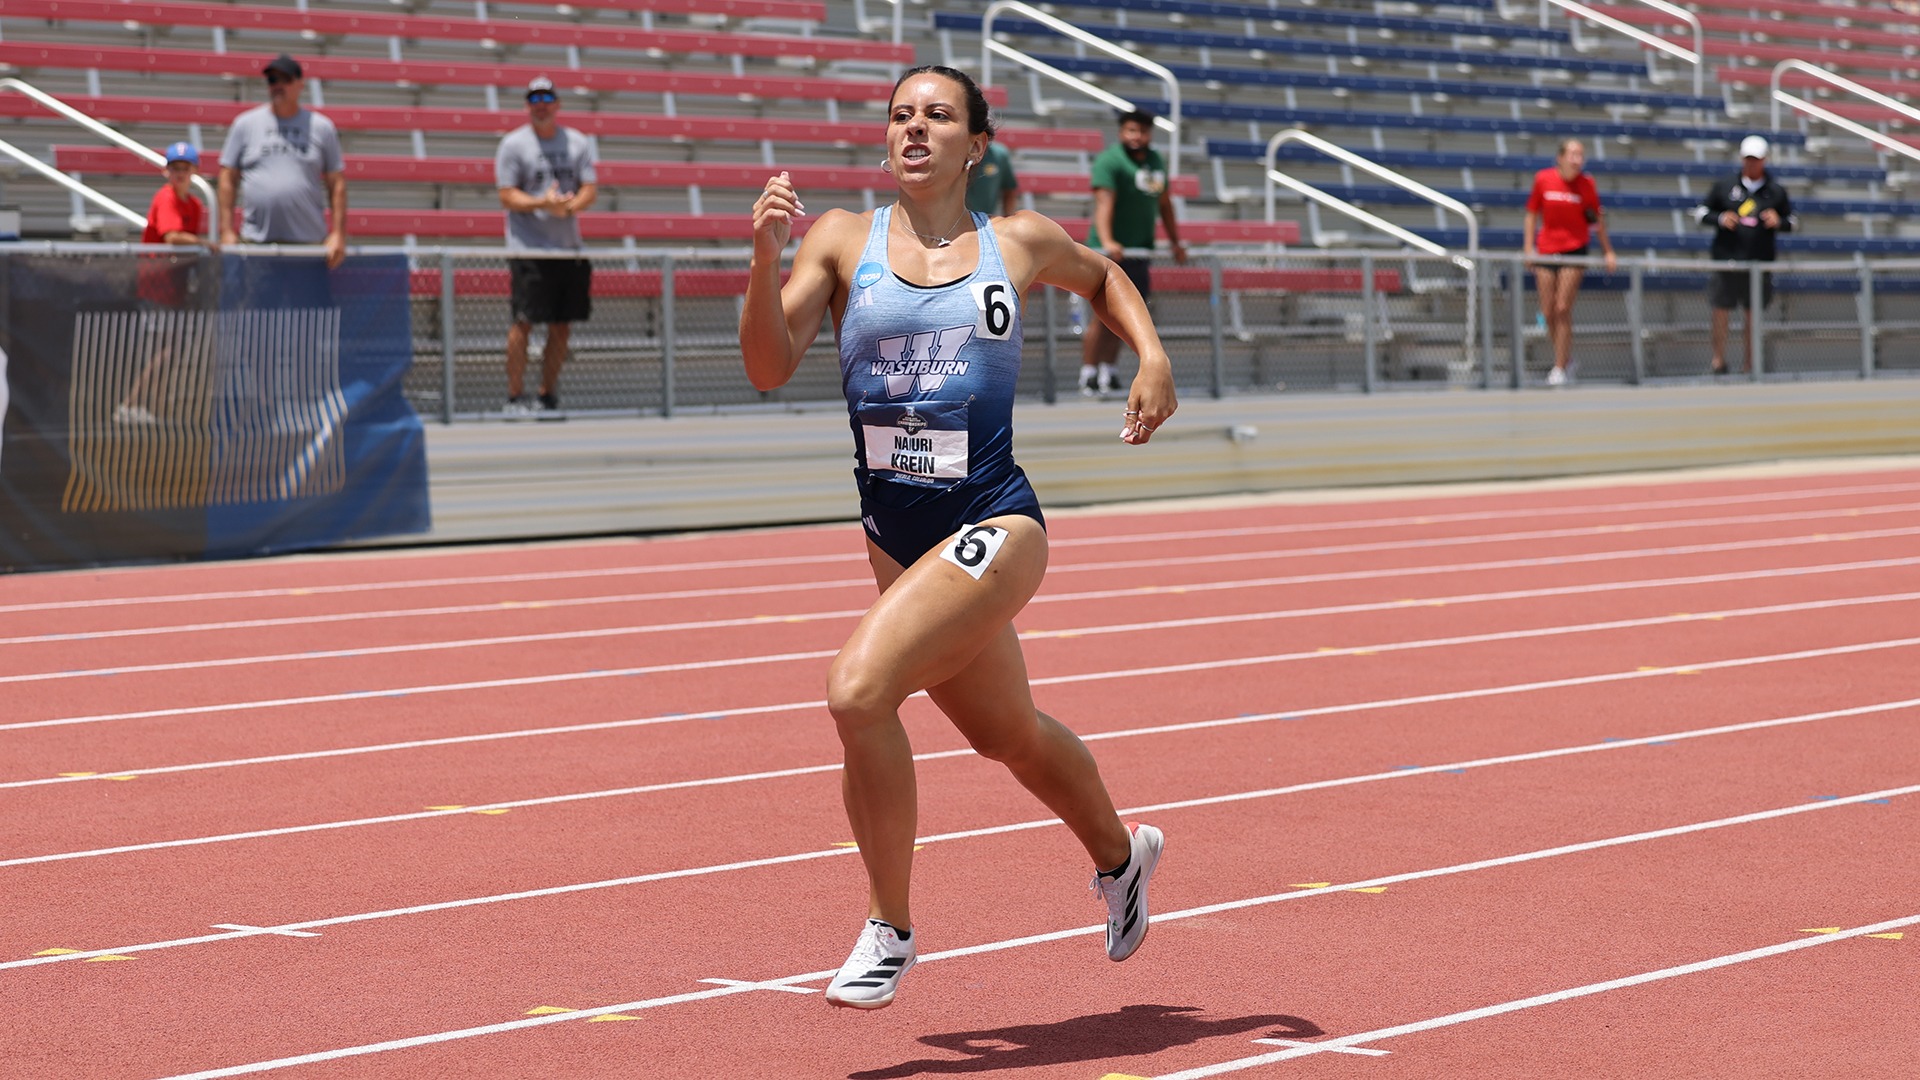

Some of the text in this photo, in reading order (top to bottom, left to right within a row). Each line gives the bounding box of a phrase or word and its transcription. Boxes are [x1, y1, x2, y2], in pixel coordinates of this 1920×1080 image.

[983, 285, 1010, 336] 6
[870, 360, 970, 376] WASHBURN
[877, 323, 976, 399] W
[894, 435, 933, 452] NAIURI
[891, 453, 935, 474] KREIN
[954, 526, 997, 567] 6
